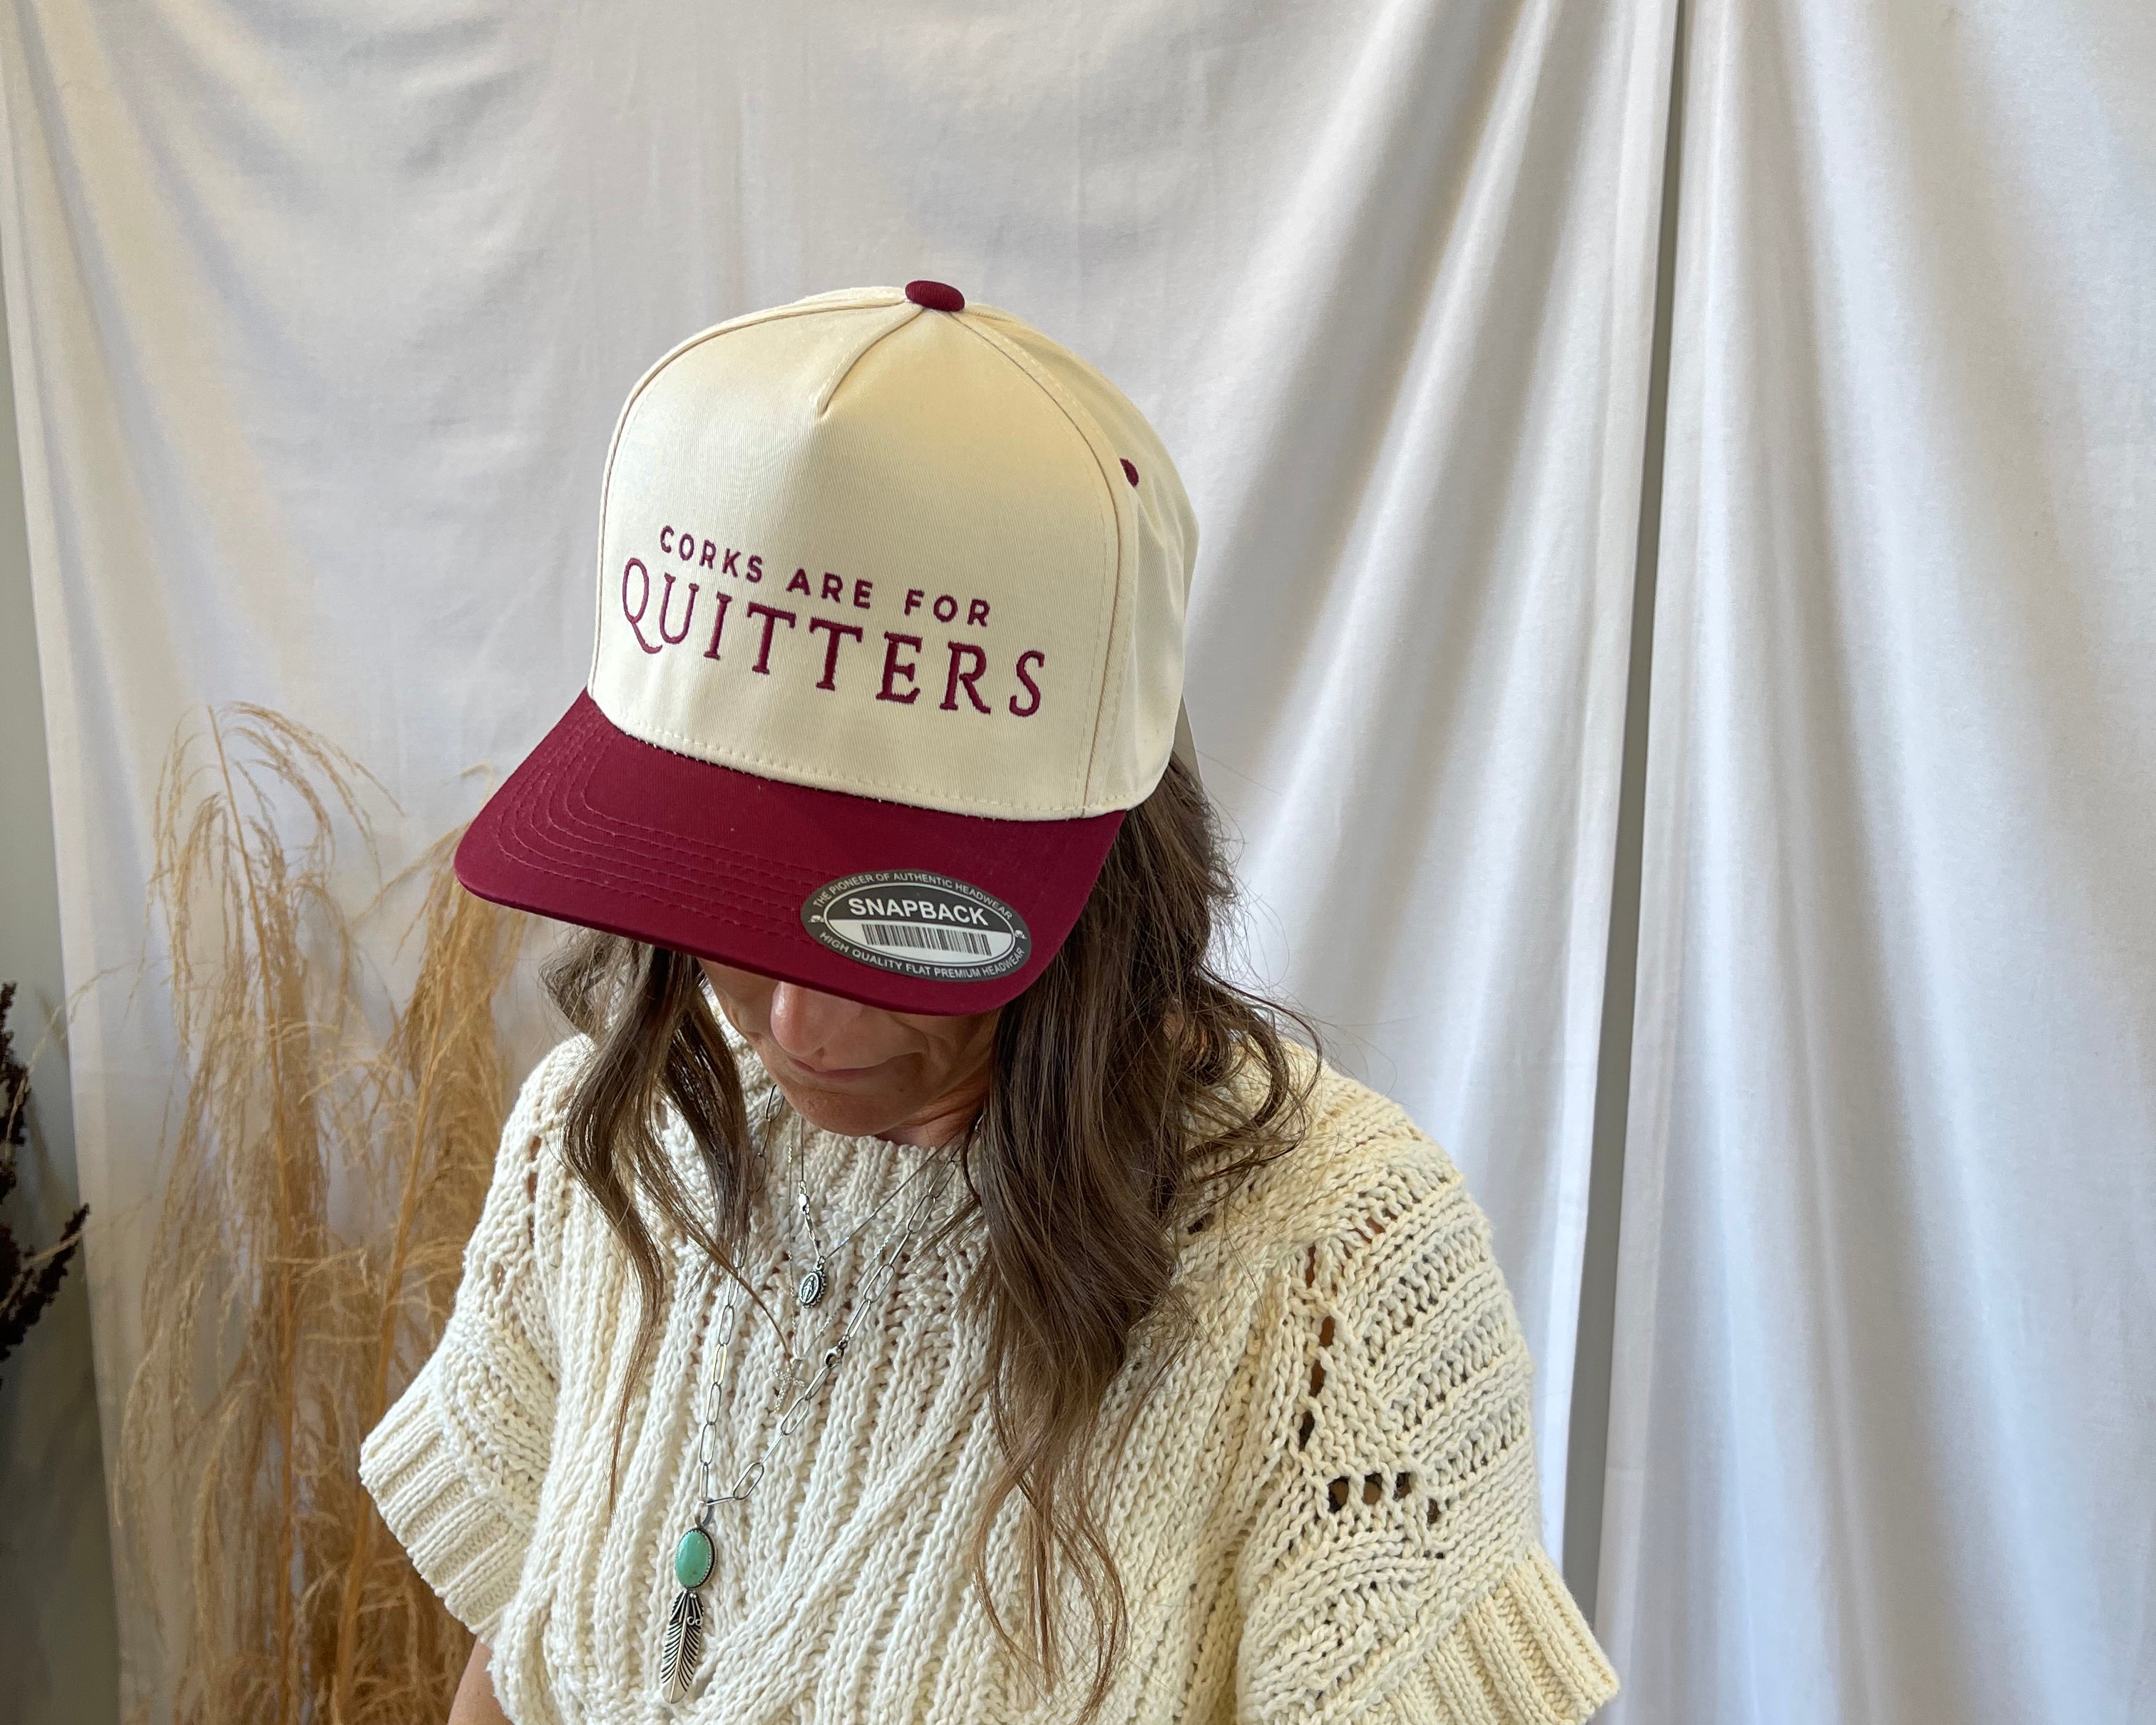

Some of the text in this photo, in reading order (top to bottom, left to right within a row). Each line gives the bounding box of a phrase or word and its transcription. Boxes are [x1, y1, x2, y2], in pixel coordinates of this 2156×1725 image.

[659, 526, 990, 627] CORKS ARE FOR
[622, 557, 1045, 717] QUITTERS
[814, 872, 1012, 919] THE PIONEER OF AUTHENTIC HEADWEAR
[848, 898, 988, 926] SNAPBACK
[820, 932, 1025, 978] HIGH QUALITY FLAT PREMIUM HEADWEAR
